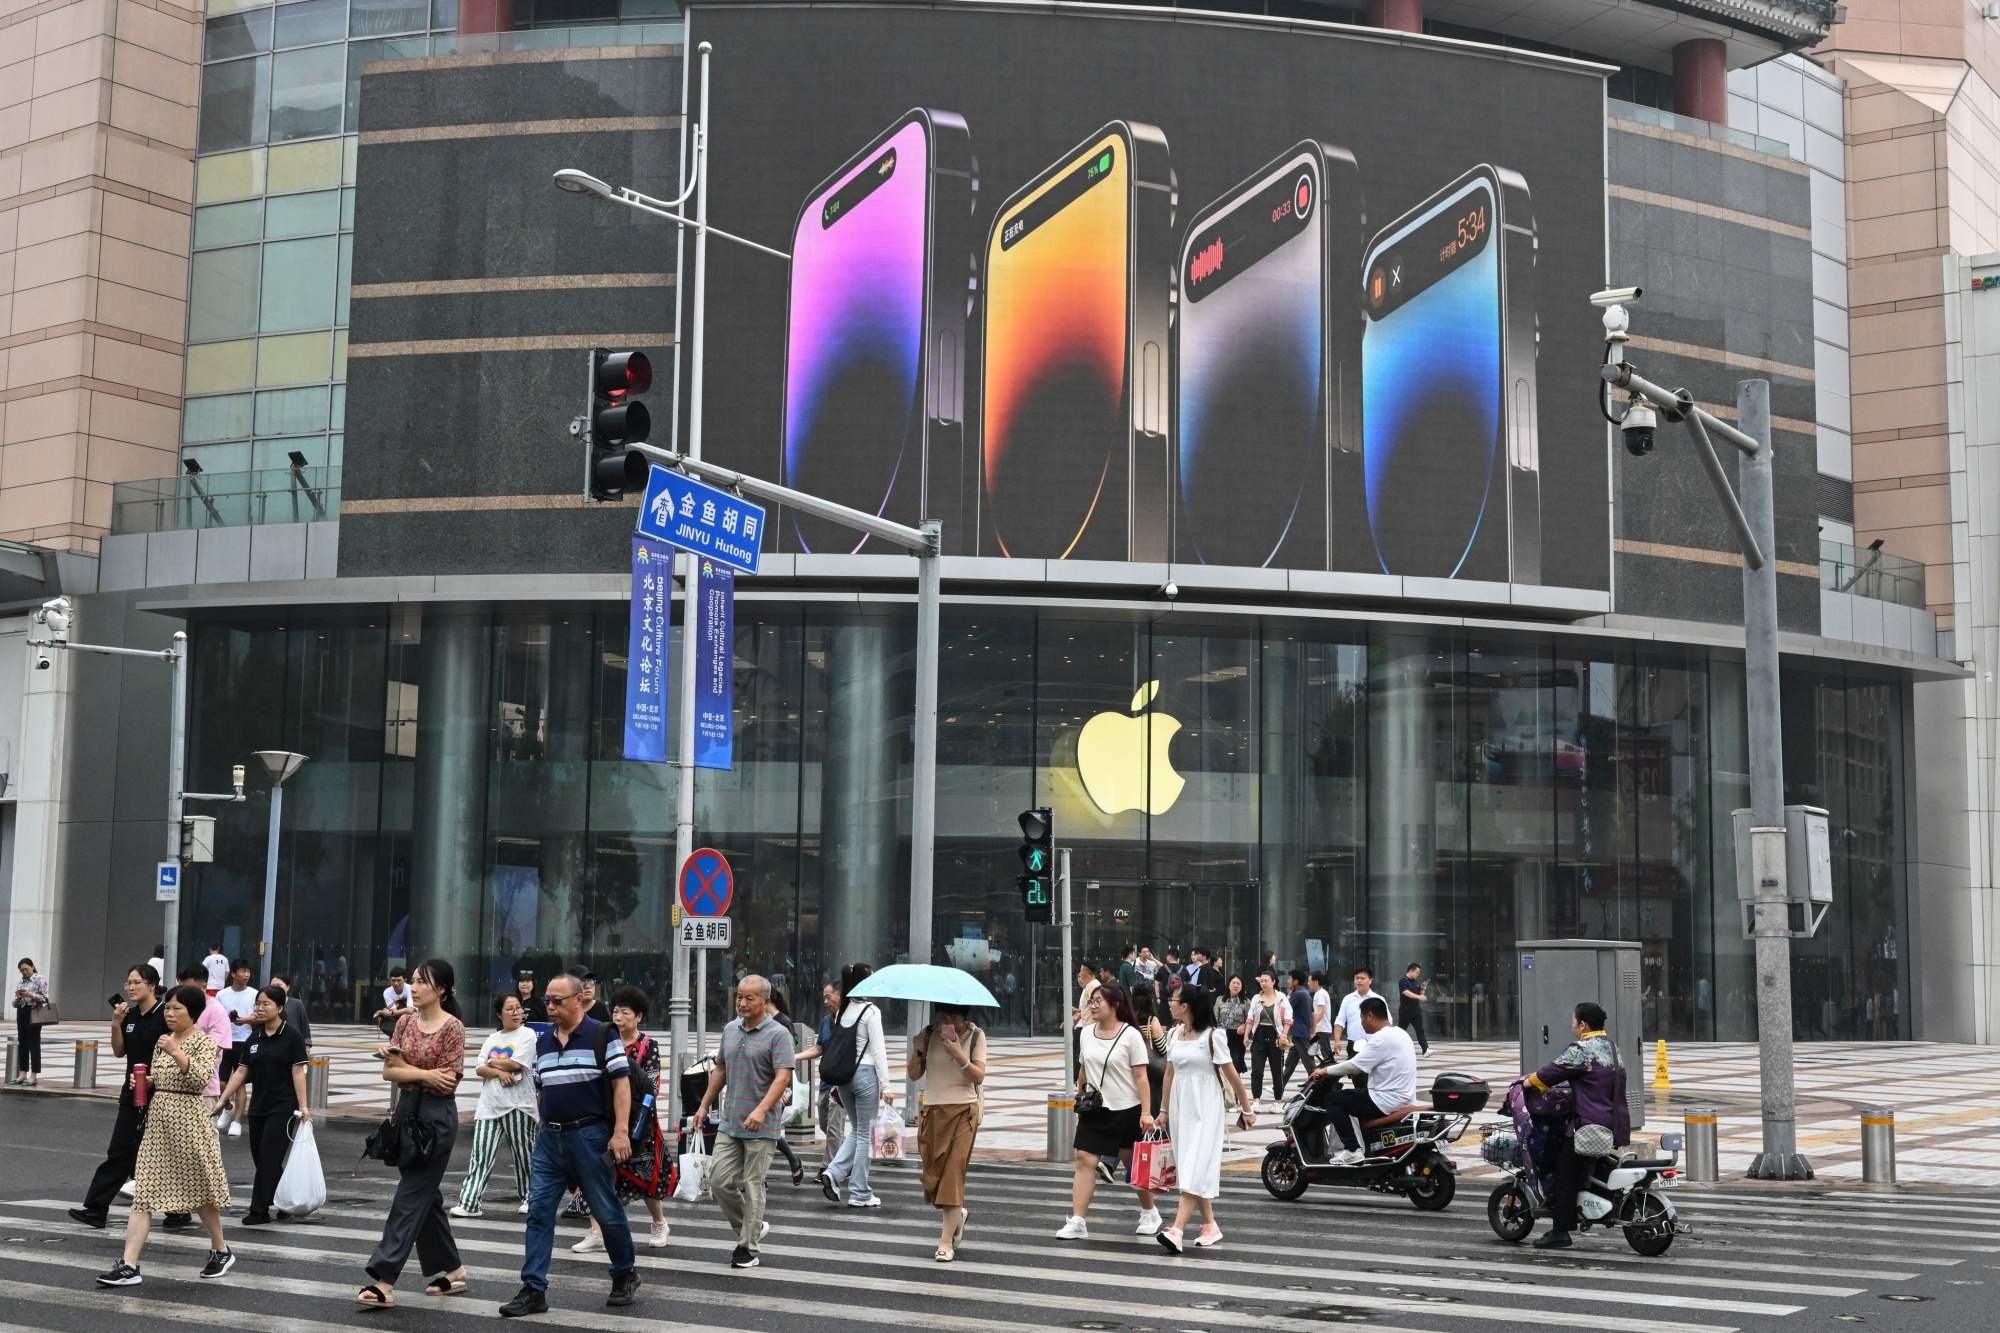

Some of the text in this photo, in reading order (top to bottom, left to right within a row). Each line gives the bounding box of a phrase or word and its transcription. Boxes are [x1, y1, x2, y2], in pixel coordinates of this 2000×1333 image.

[1087, 165, 1099, 179] 75%
[1272, 200, 1291, 222] 00:33
[1440, 206, 1485, 262] 计时器 5:34
[659, 497, 669, 512] 东
[659, 514, 666, 524] E
[679, 491, 758, 541] 金鱼胡同
[676, 523, 752, 564] JINYU Hutong
[640, 572, 654, 694] 北京文化论坛
[654, 577, 664, 694] Beijing Culture Forum
[683, 922, 728, 941] 金鱼胡同
[1382, 1133, 1395, 1145] 02
[1583, 1199, 1600, 1208] ONLY
